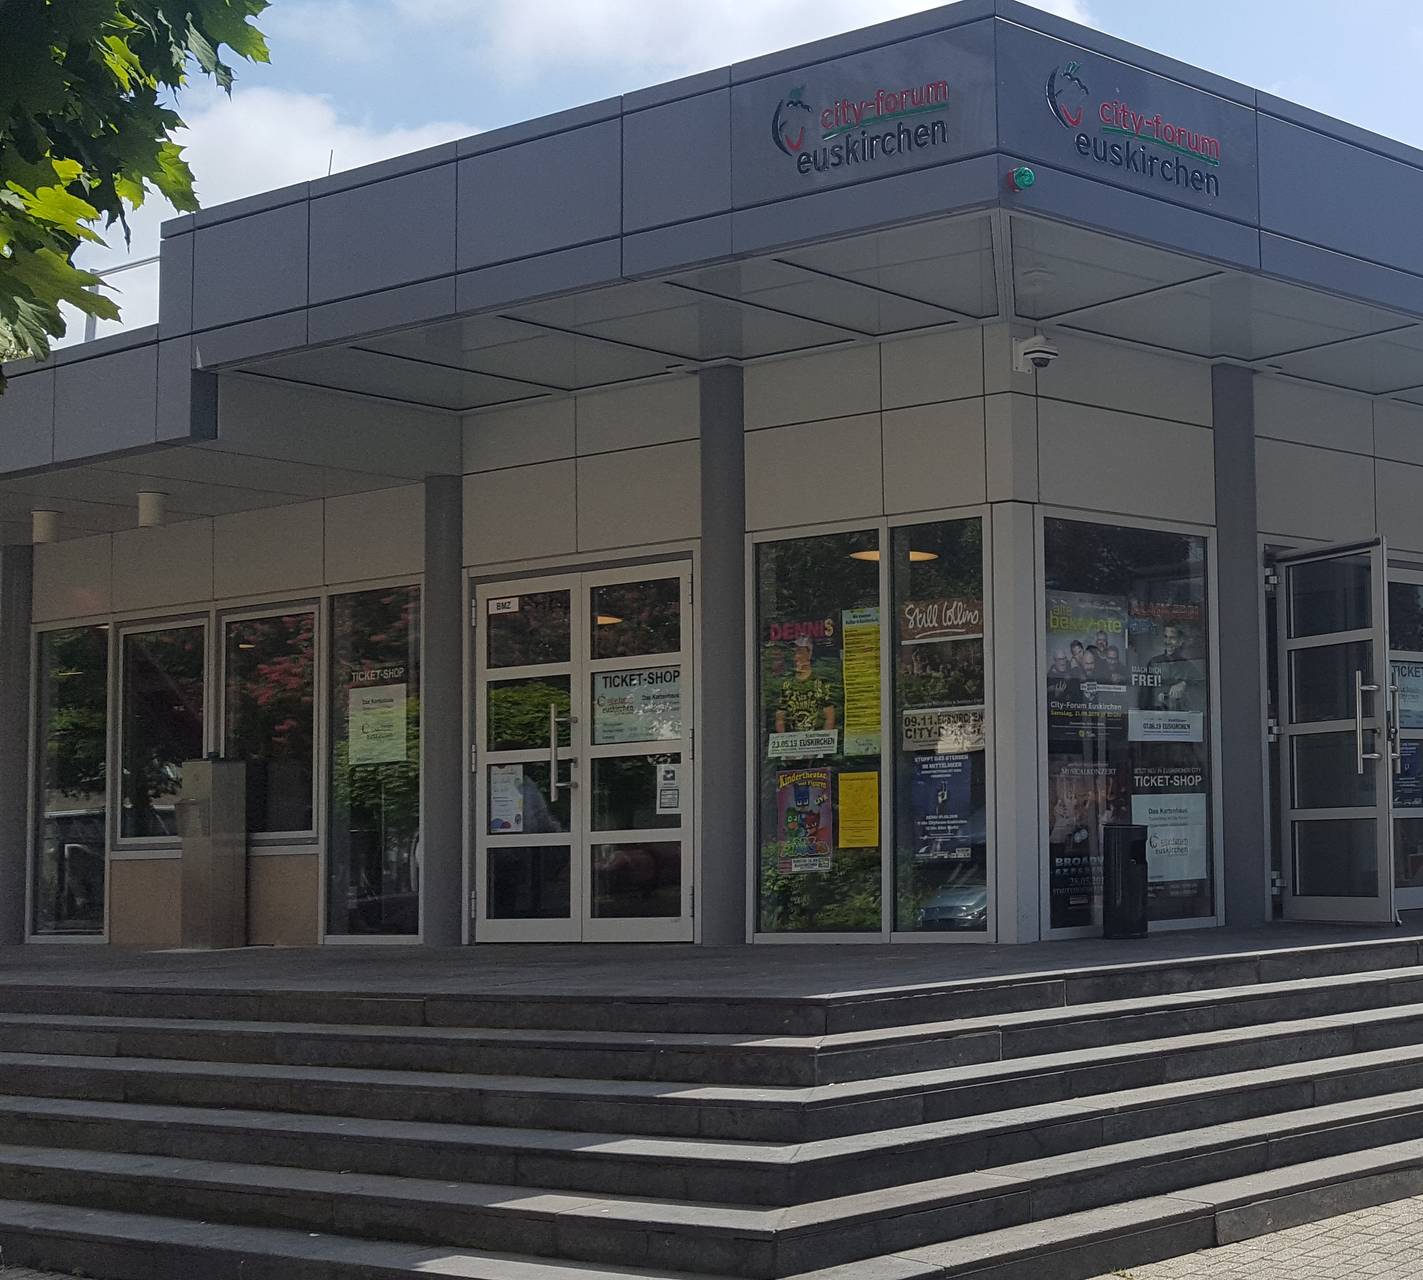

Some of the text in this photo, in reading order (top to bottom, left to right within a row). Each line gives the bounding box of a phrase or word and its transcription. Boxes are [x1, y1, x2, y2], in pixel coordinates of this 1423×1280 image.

[820, 78, 949, 130] city-forum
[1099, 100, 1221, 158] city-forum
[796, 117, 949, 174] euskirchen
[1074, 129, 1220, 197] euskirchen
[905, 604, 938, 629] Still
[769, 618, 835, 641] DENNIS
[351, 667, 405, 682] TICKET-SHOP
[602, 670, 680, 688] TICKET-SHOP
[1131, 674, 1161, 686] FREI!
[799, 737, 835, 748] EUSKIRCHEN
[1133, 775, 1202, 787] TICKET-SHOP
